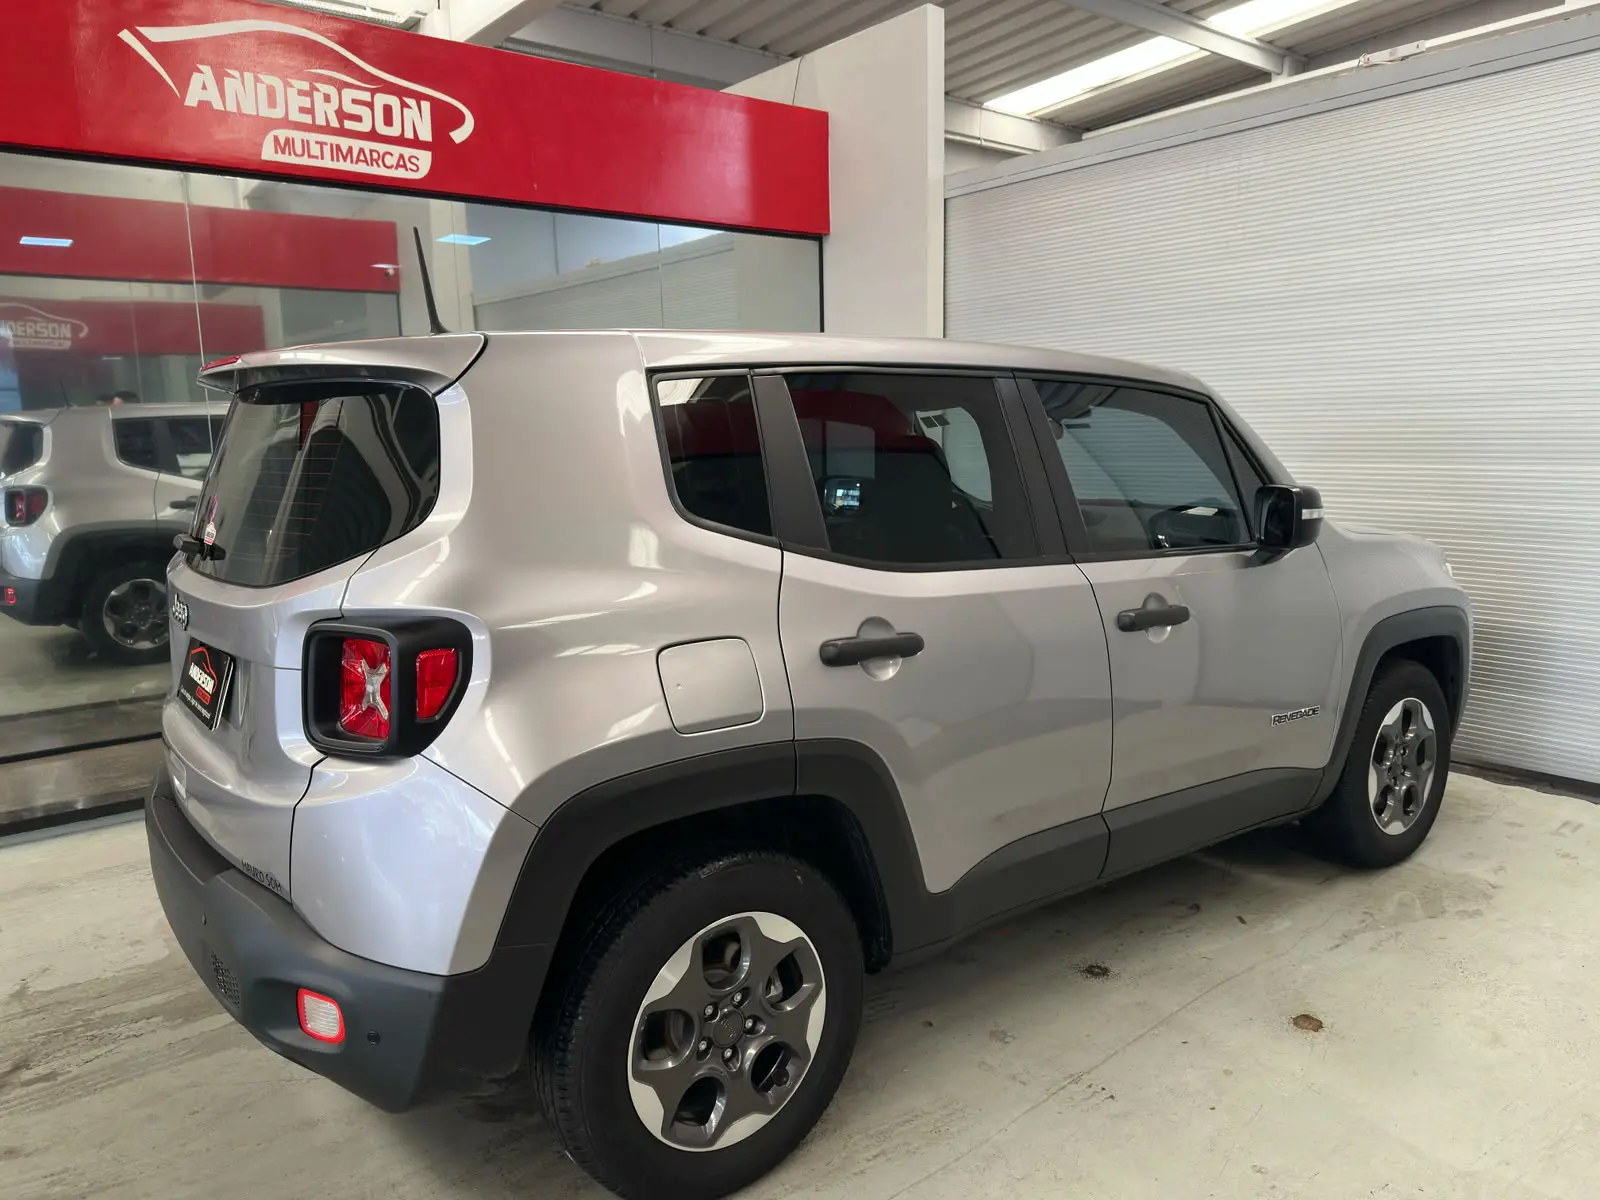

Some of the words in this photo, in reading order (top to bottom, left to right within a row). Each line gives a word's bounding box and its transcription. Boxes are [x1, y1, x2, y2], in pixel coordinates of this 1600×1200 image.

[184, 63, 433, 142] ANDERSON
[272, 134, 420, 173] MULTIMARCAS
[1271, 705, 1320, 727] RENEGADE
